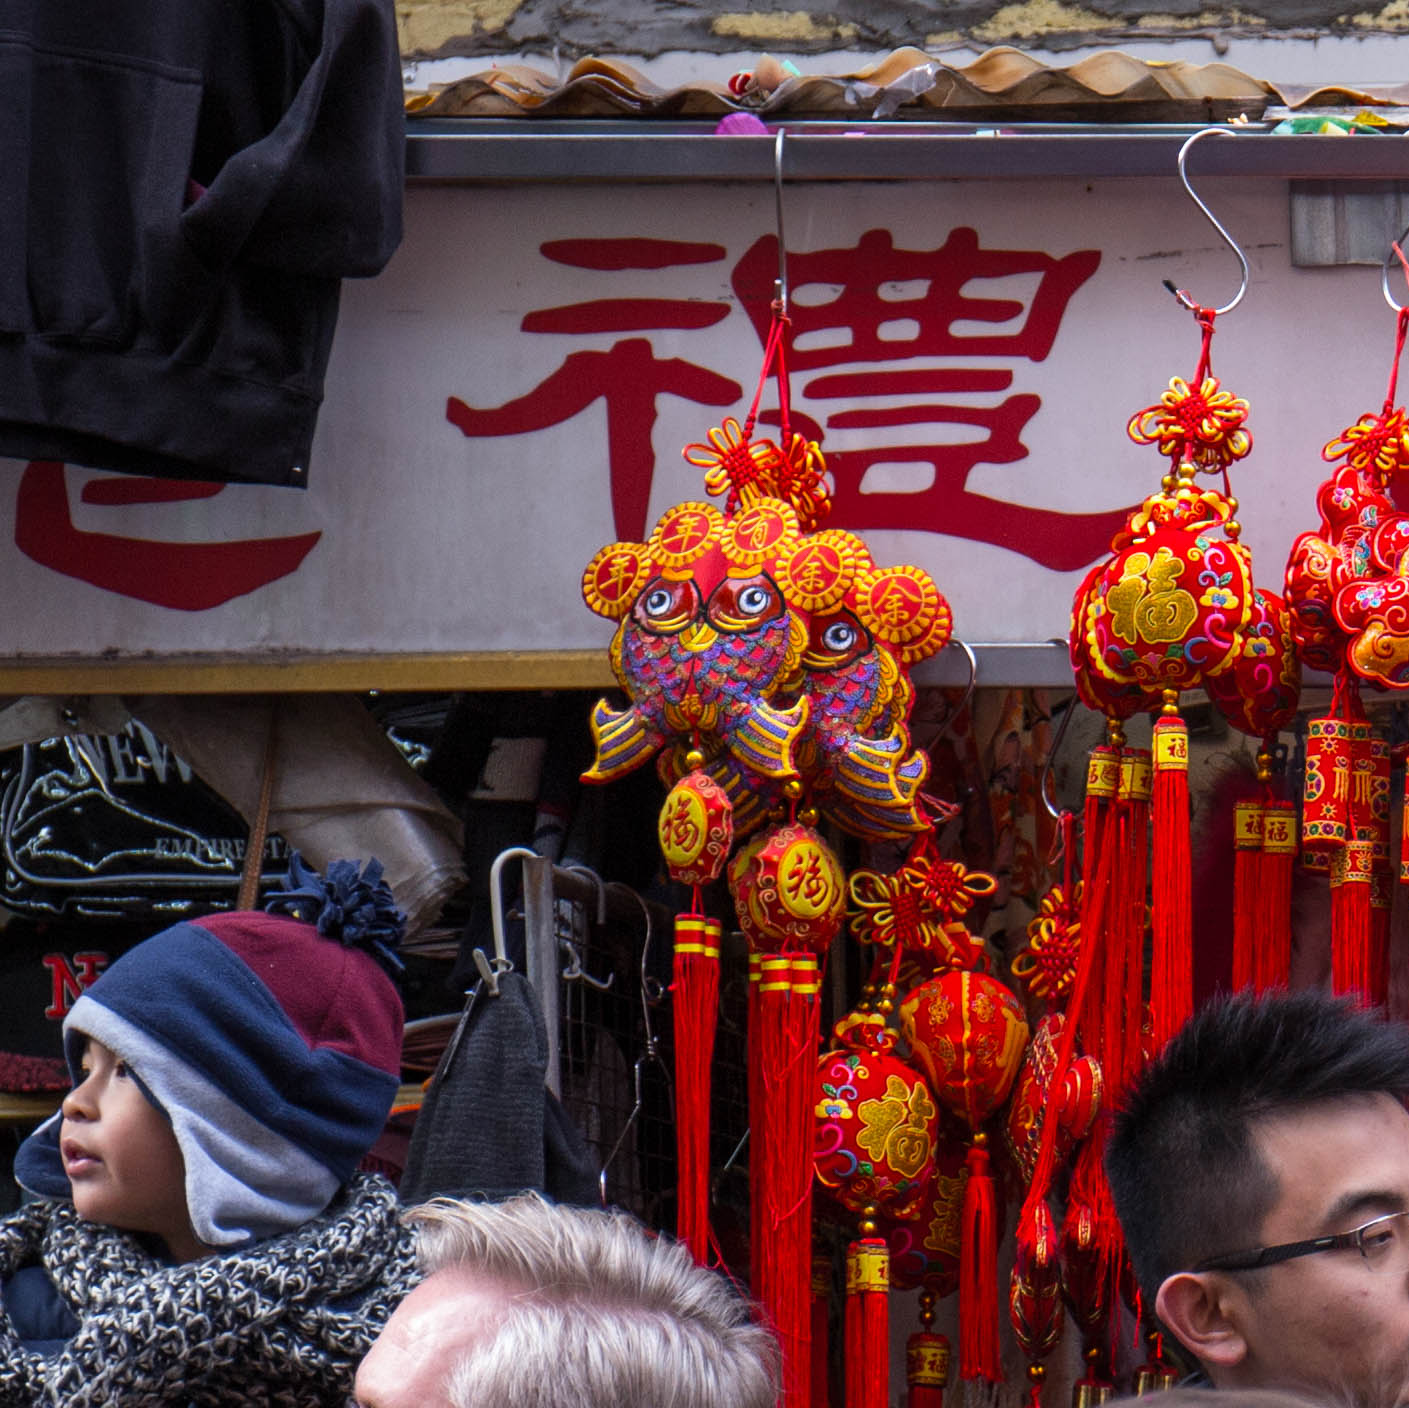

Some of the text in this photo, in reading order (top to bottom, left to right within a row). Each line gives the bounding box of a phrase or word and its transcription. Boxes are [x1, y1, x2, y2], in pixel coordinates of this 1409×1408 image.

[1107, 547, 1199, 645] 福
[1167, 737, 1187, 759] 福
[1267, 820, 1290, 843] 福
[856, 1074, 936, 1179] 福
